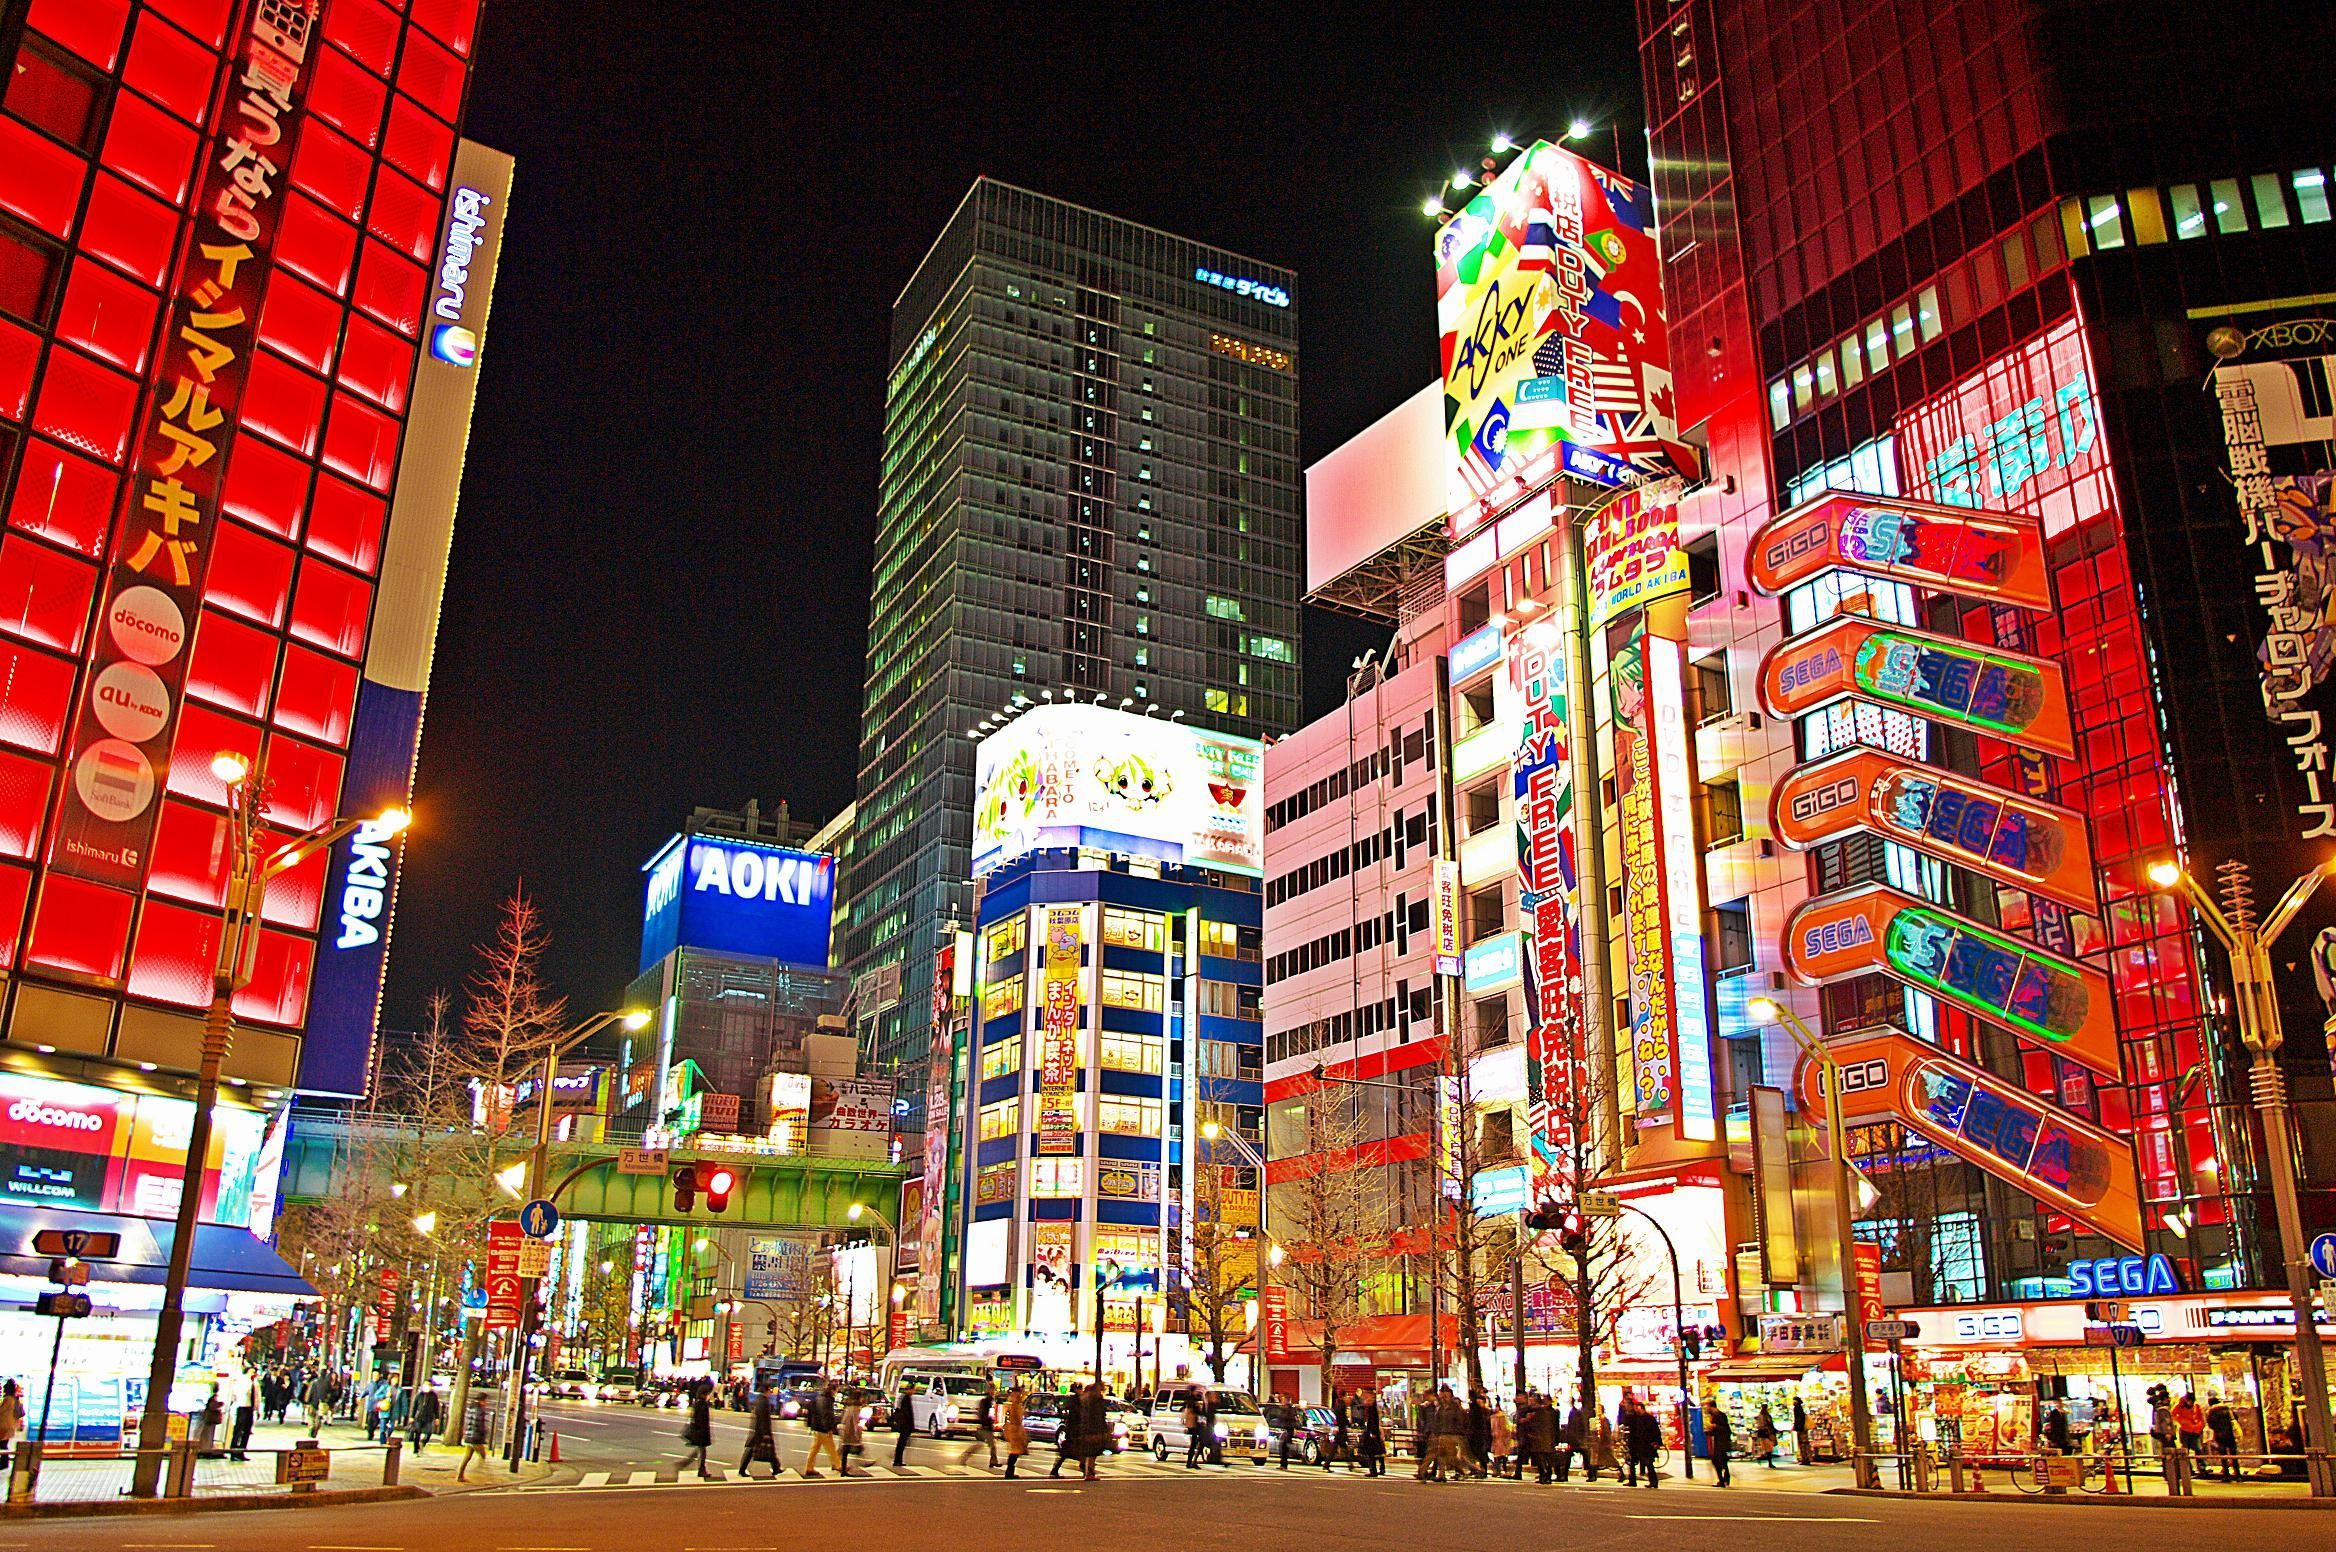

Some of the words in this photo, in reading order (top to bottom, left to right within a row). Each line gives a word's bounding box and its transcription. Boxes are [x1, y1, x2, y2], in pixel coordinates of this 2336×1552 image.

[433, 188, 490, 320] ishimaru
[1556, 248, 1590, 338] DUTY
[1494, 333, 1529, 374] ONE
[2253, 320, 2334, 351] XBOX
[1563, 340, 1595, 438] FREE
[1768, 525, 1829, 568] GiGO
[1611, 582, 1643, 606] WORLD
[1647, 568, 1687, 590] AKIBA
[114, 608, 180, 643] docomo
[1780, 648, 1843, 695] SEGA
[99, 686, 131, 708] au
[139, 703, 164, 720] KDDI
[1523, 650, 1552, 762] DUTY
[2280, 709, 2336, 840] フォース
[90, 789, 132, 811] SoftBank
[1793, 777, 1858, 819] GiGO
[1529, 767, 1562, 892] FREE
[66, 838, 119, 865] ishimaru
[337, 821, 393, 949] AKIBA
[695, 847, 812, 907] AOKI
[1805, 915, 1873, 958] SEGA
[1043, 980, 1062, 1084] まんが喫茶
[1061, 979, 1077, 1084] インターネット
[9, 1098, 103, 1132] docomo
[829, 1117, 888, 1132] カラオケ
[623, 1151, 664, 1164] 万世橋
[8, 1180, 76, 1198] WILLCOM
[67, 1234, 85, 1250] 17
[2067, 1254, 2179, 1299] SEGA
